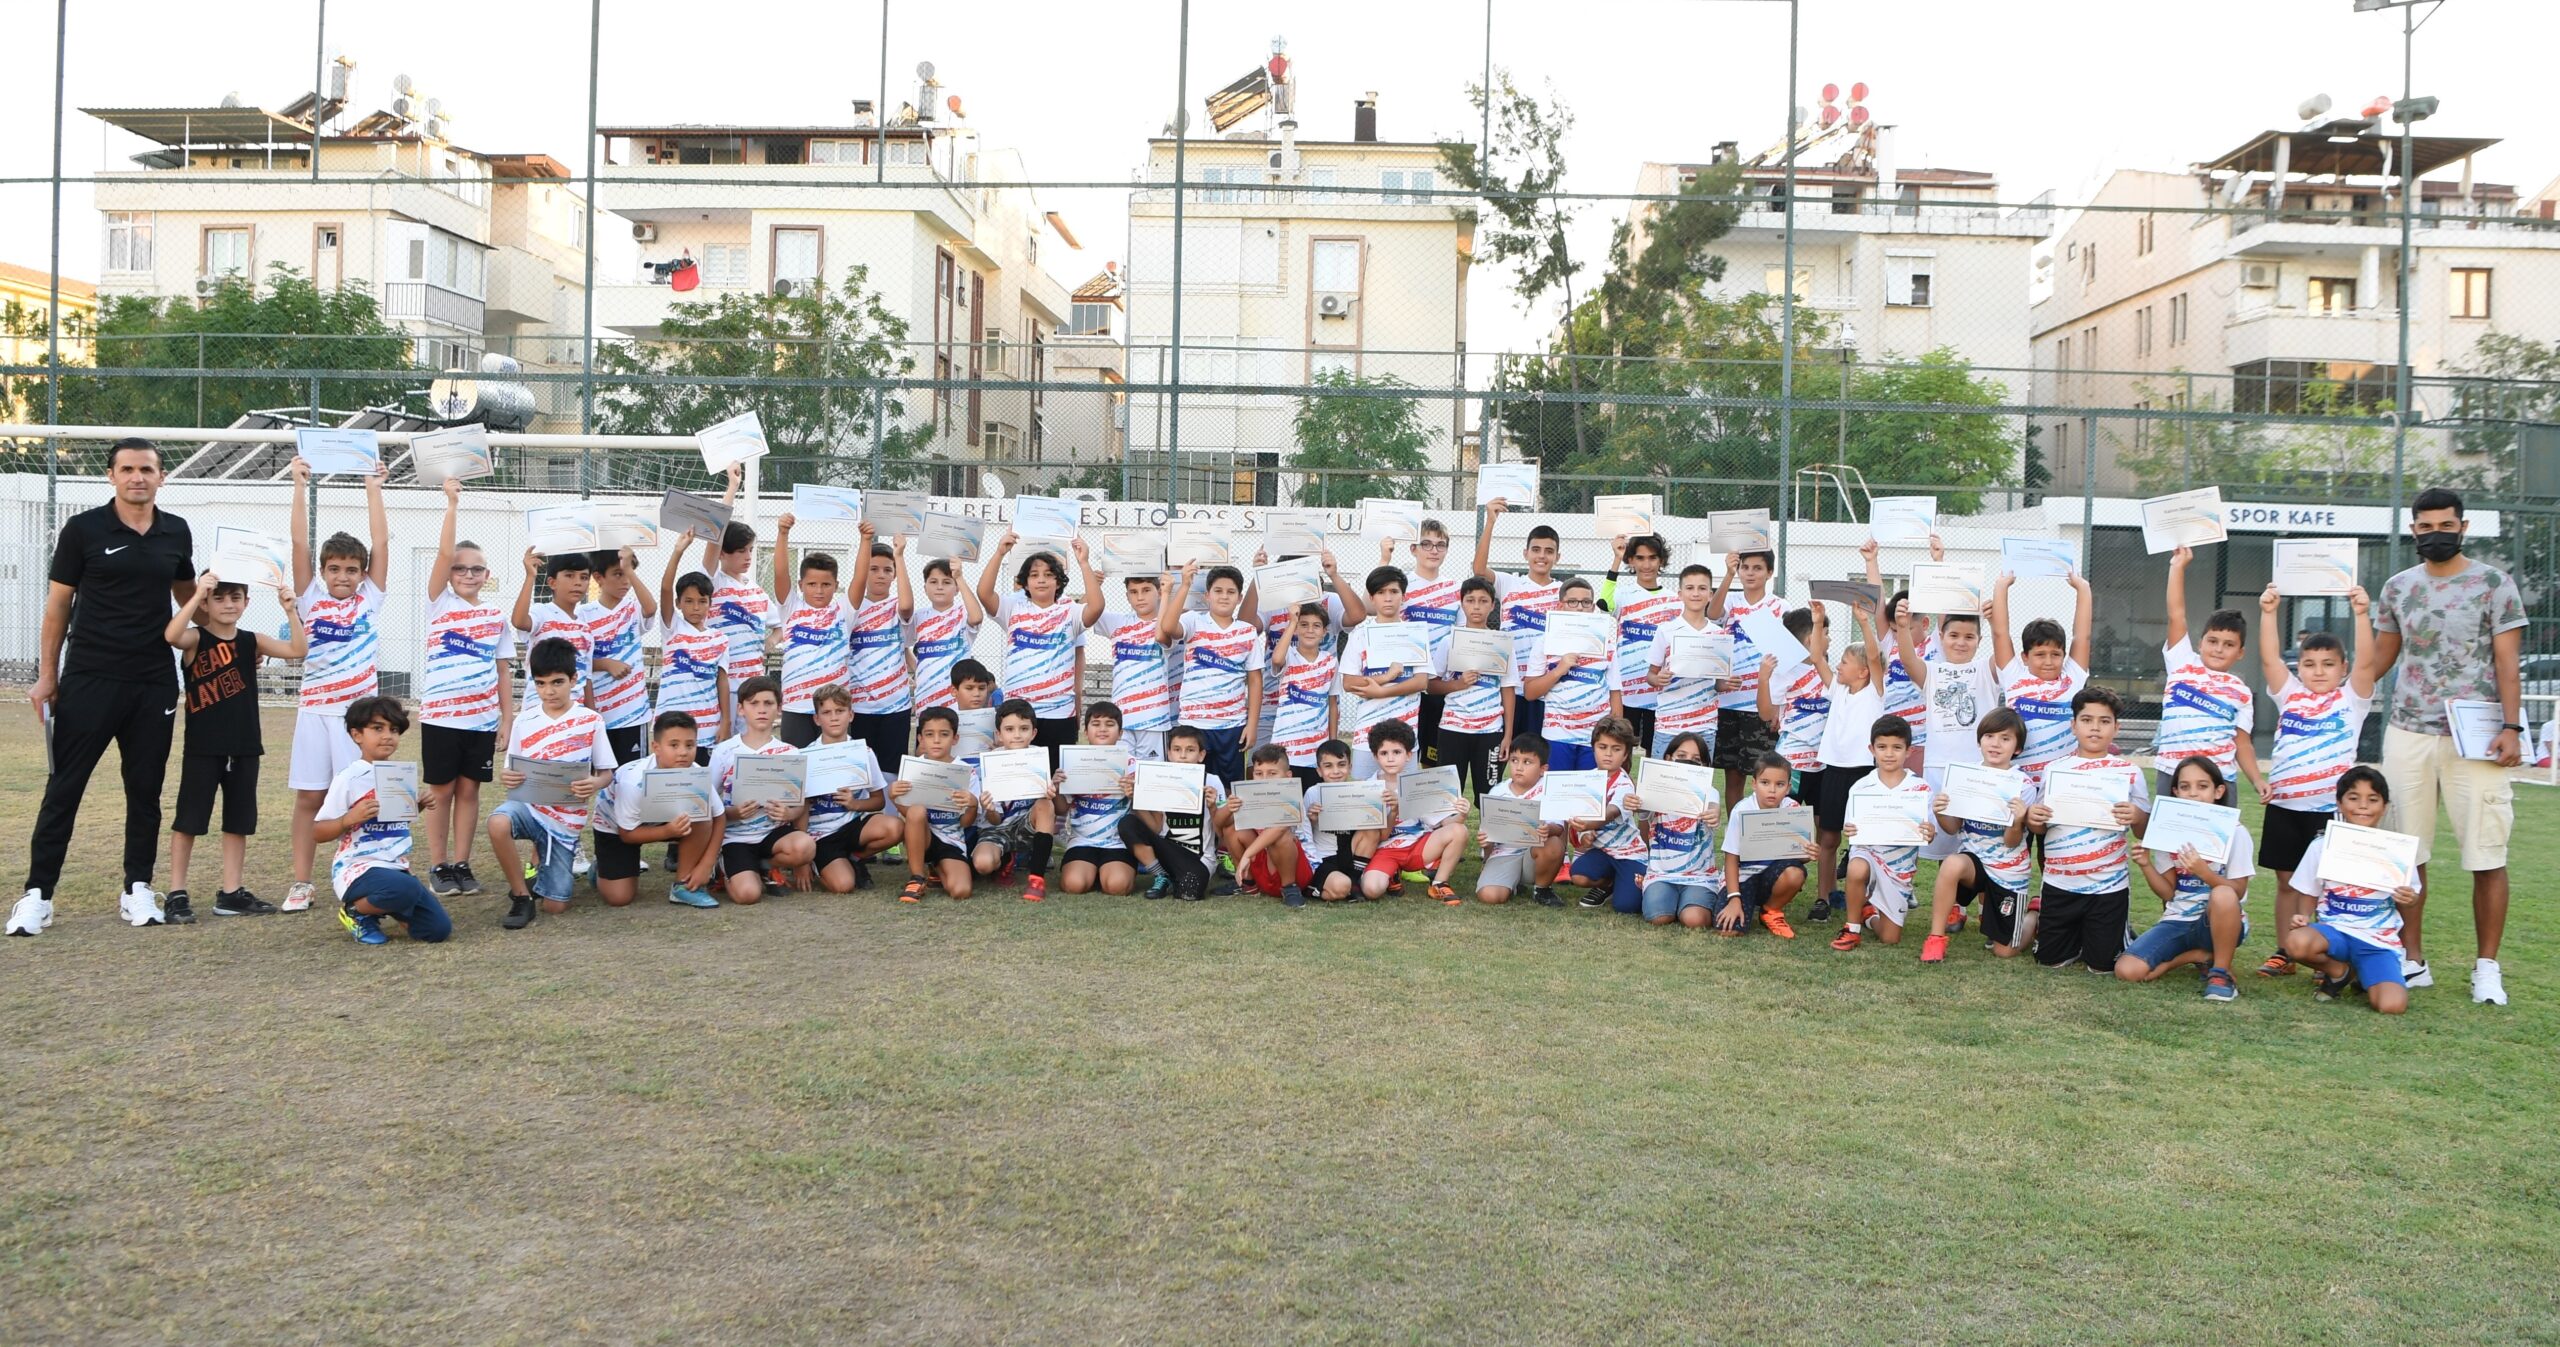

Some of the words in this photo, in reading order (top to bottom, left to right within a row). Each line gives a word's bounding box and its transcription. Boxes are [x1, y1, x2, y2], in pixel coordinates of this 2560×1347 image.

[2230, 508, 2280, 524] SPOR
[2288, 510, 2336, 526] KAFE
[1411, 611, 1426, 619] YAZ
[1516, 611, 1530, 621] YAZ
[317, 625, 333, 636] YAZ
[1626, 626, 1640, 635] YAZ
[450, 637, 466, 648] YAZ
[1198, 653, 1213, 663] YAZ
[2176, 688, 2192, 701] YAZ
[2019, 703, 2036, 713] YAZ
[1488, 763, 1499, 787] Surf
[365, 822, 385, 832] YAZ
[2330, 900, 2346, 910] YAZ
